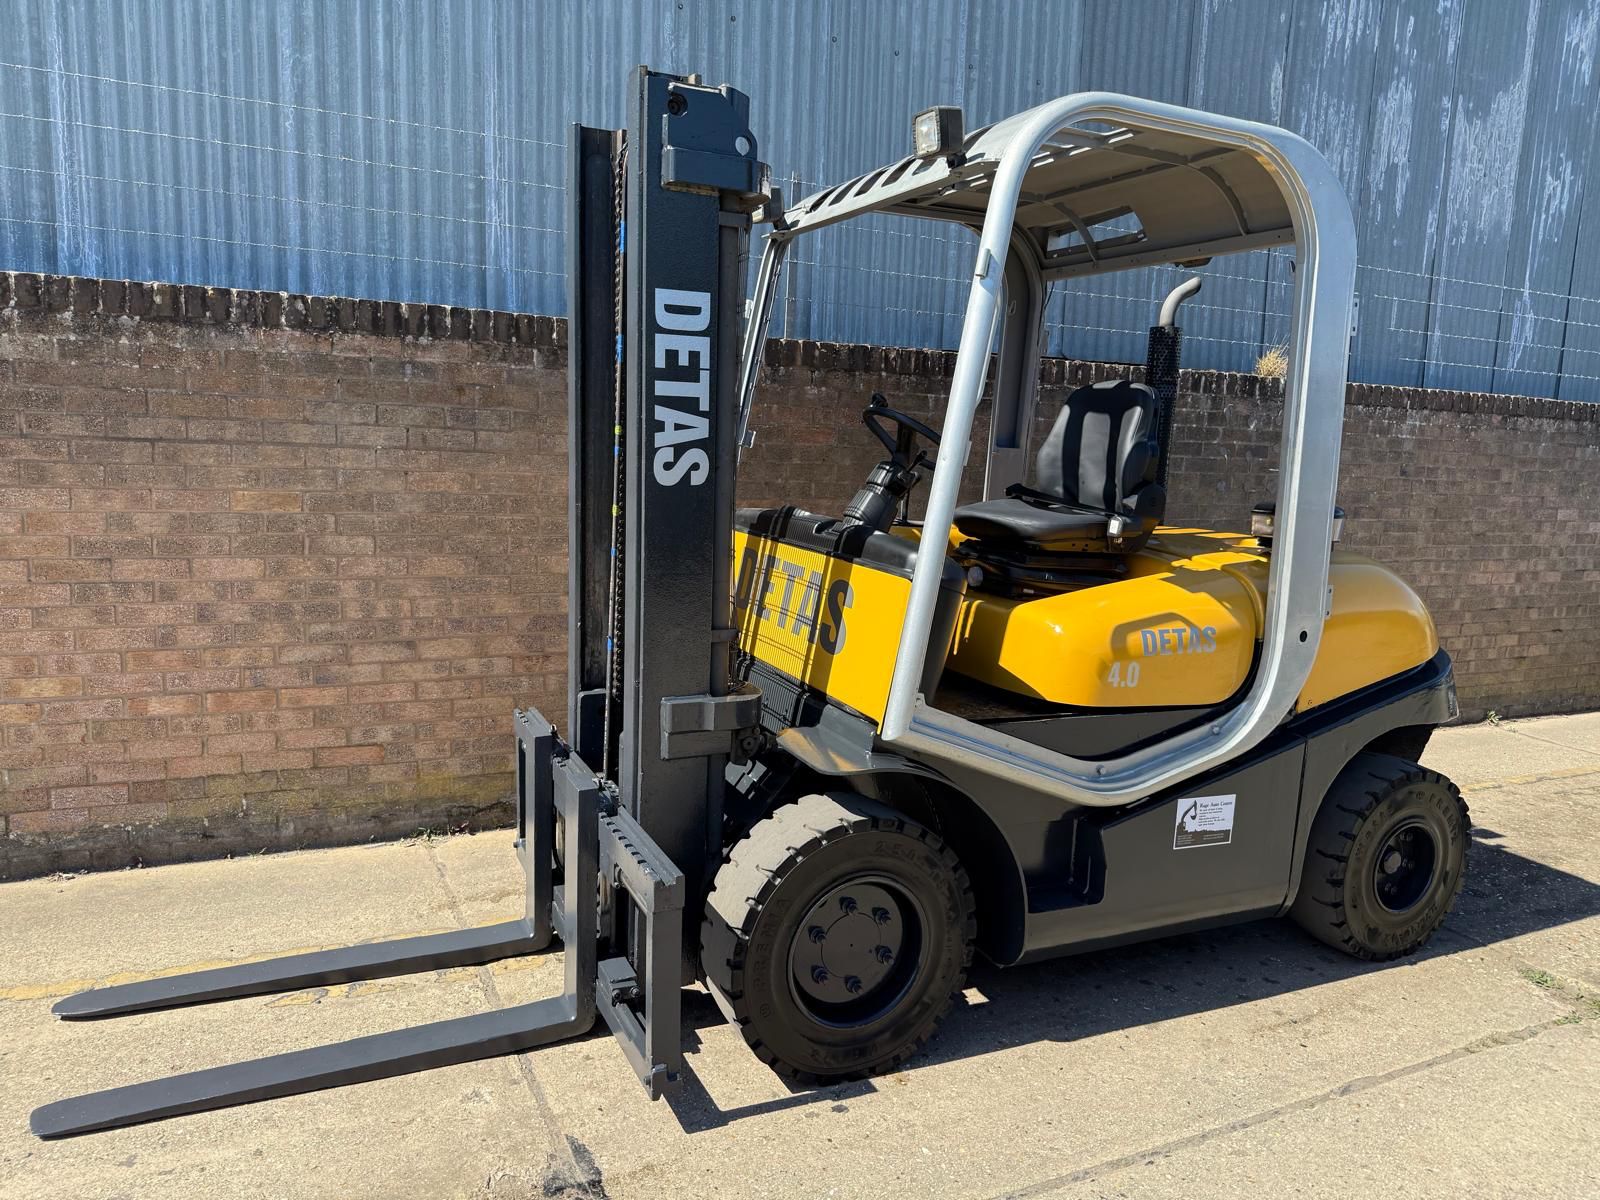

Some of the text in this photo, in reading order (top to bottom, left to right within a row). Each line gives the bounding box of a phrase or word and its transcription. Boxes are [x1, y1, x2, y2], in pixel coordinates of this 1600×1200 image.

[653, 287, 711, 487] DETAS
[735, 546, 855, 656] DETAS
[1107, 661, 1141, 688] 4.0
[1141, 625, 1217, 657] DETAS
